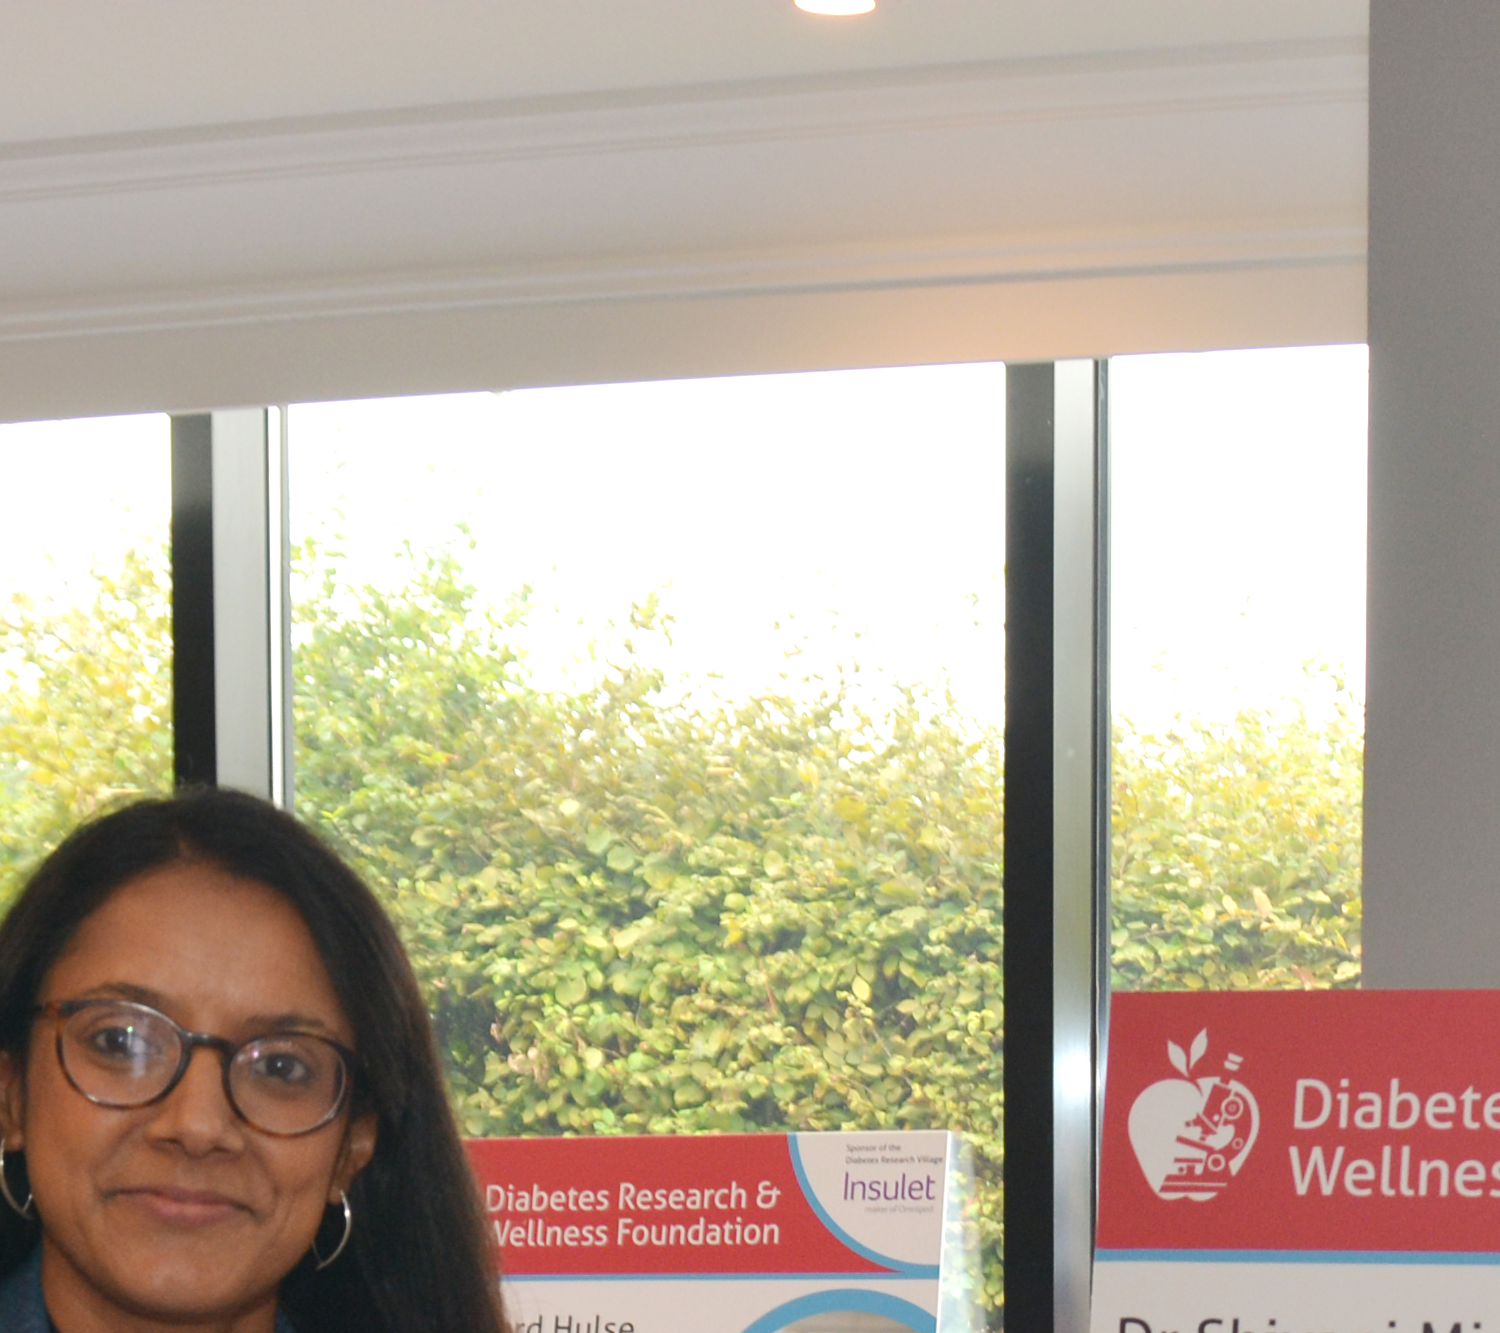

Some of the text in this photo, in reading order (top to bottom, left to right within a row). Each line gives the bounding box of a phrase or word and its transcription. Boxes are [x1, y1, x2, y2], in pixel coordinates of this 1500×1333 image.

[486, 1180, 781, 1212] Diabetes Research &
[843, 1171, 935, 1201] Insulet
[617, 1216, 779, 1246] Foundation
